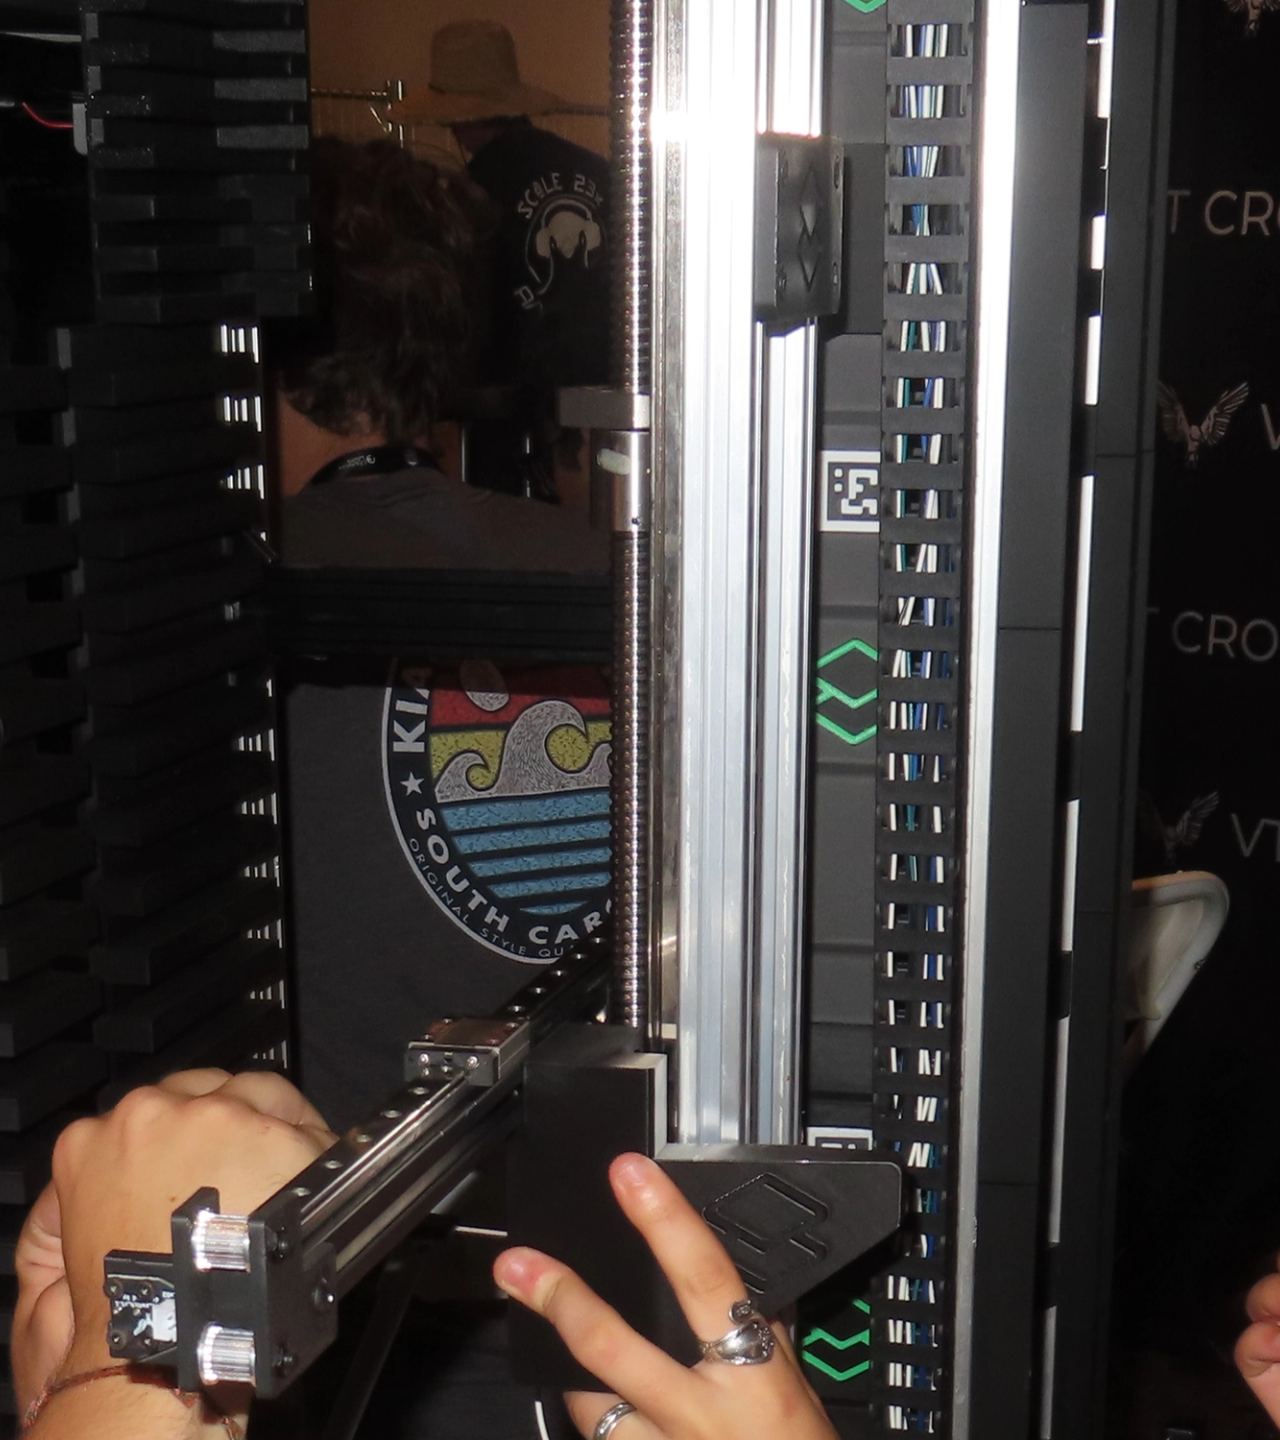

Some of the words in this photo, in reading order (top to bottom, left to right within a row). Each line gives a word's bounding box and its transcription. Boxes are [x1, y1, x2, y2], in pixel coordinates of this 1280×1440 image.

[1167, 189, 1191, 235] T
[1172, 610, 1279, 662] CRO
[409, 838, 470, 924] ORIGINAL
[480, 927, 527, 955] STYLE
[538, 944, 574, 958] QU
[416, 808, 510, 933] SOUTH
